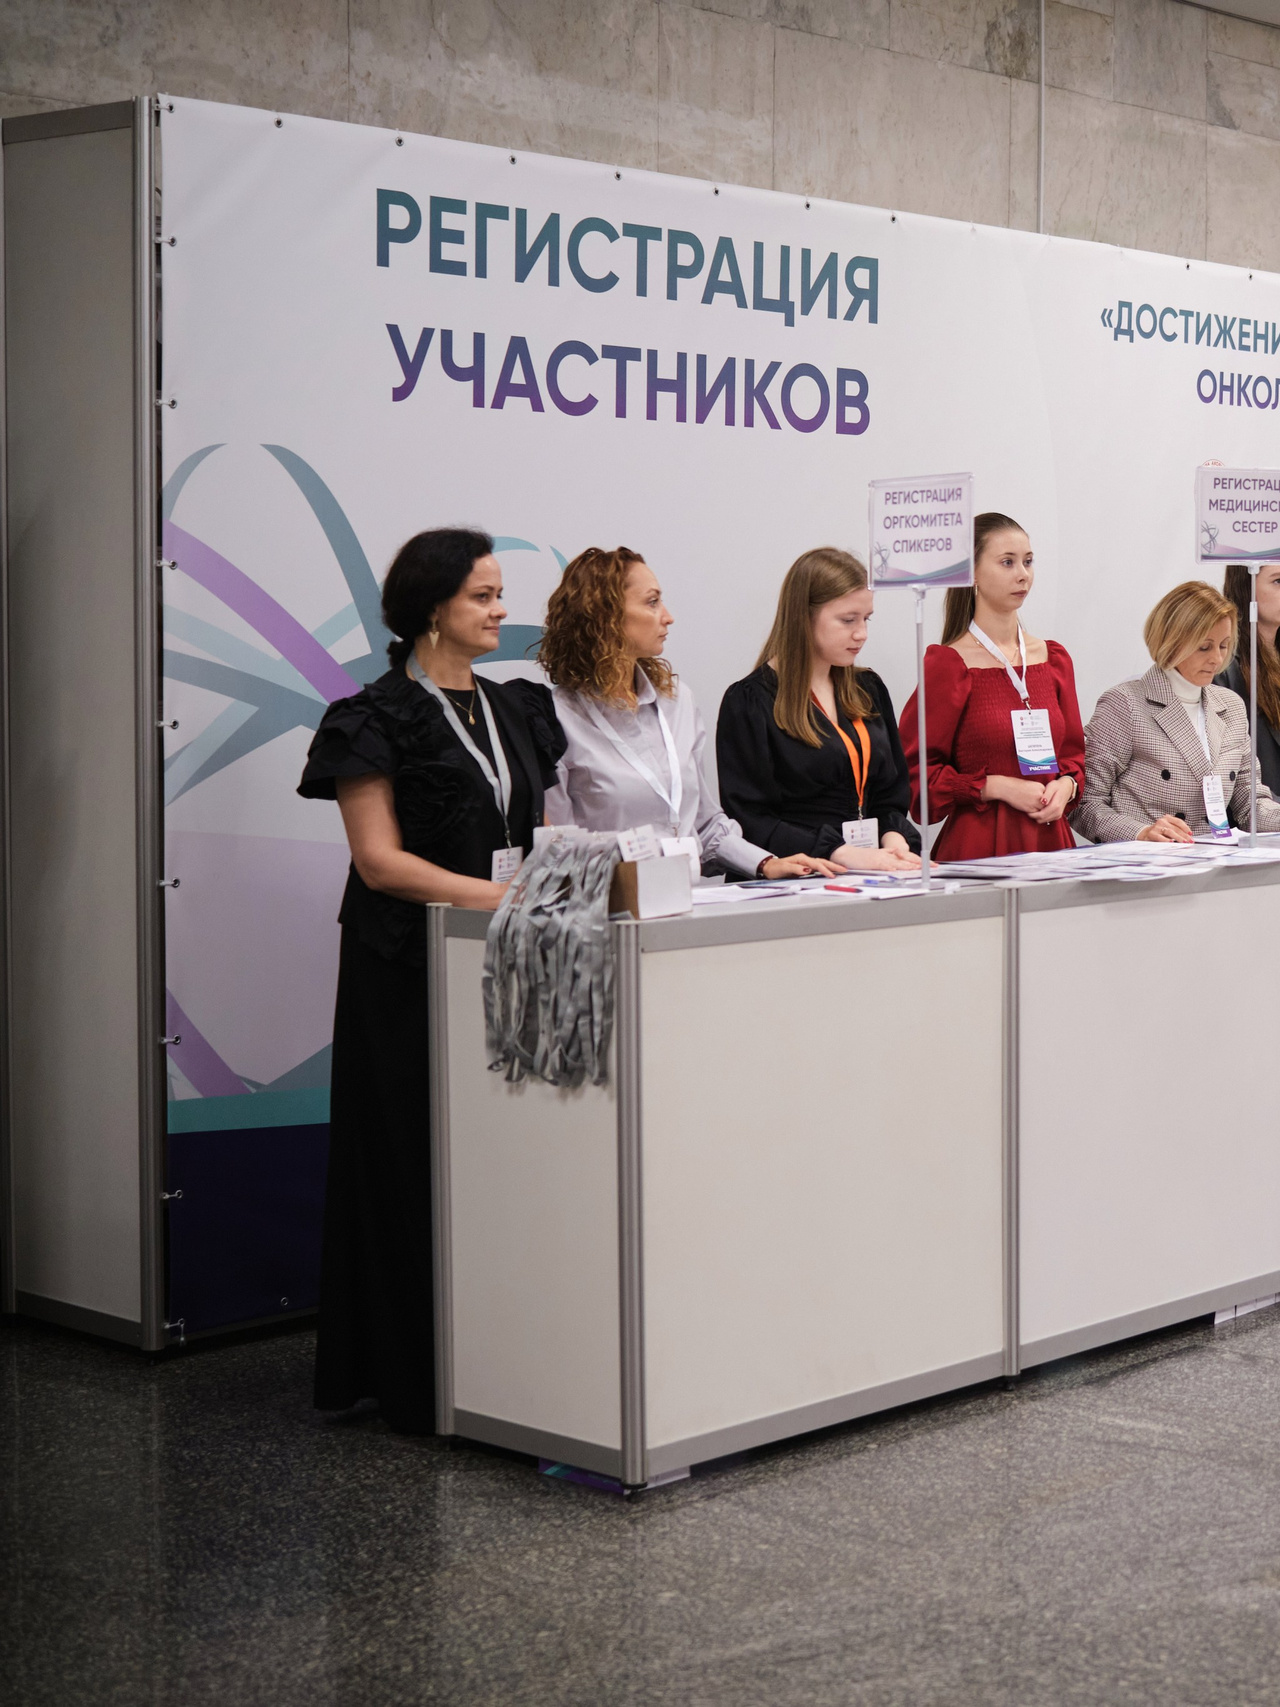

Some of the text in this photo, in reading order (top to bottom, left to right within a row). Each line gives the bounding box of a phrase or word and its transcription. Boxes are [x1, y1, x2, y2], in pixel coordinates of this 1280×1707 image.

[376, 188, 879, 328] РЕГИСТРАЦИЯ
[385, 323, 871, 436] УЧАСТНИКОВ
[884, 487, 963, 505] РЕГИСТРАЦИЯ
[883, 512, 963, 530] ОРГКОМИТЕТА
[1232, 520, 1278, 533] СЕСТЕР
[892, 537, 953, 554] СПИКЕРОВ
